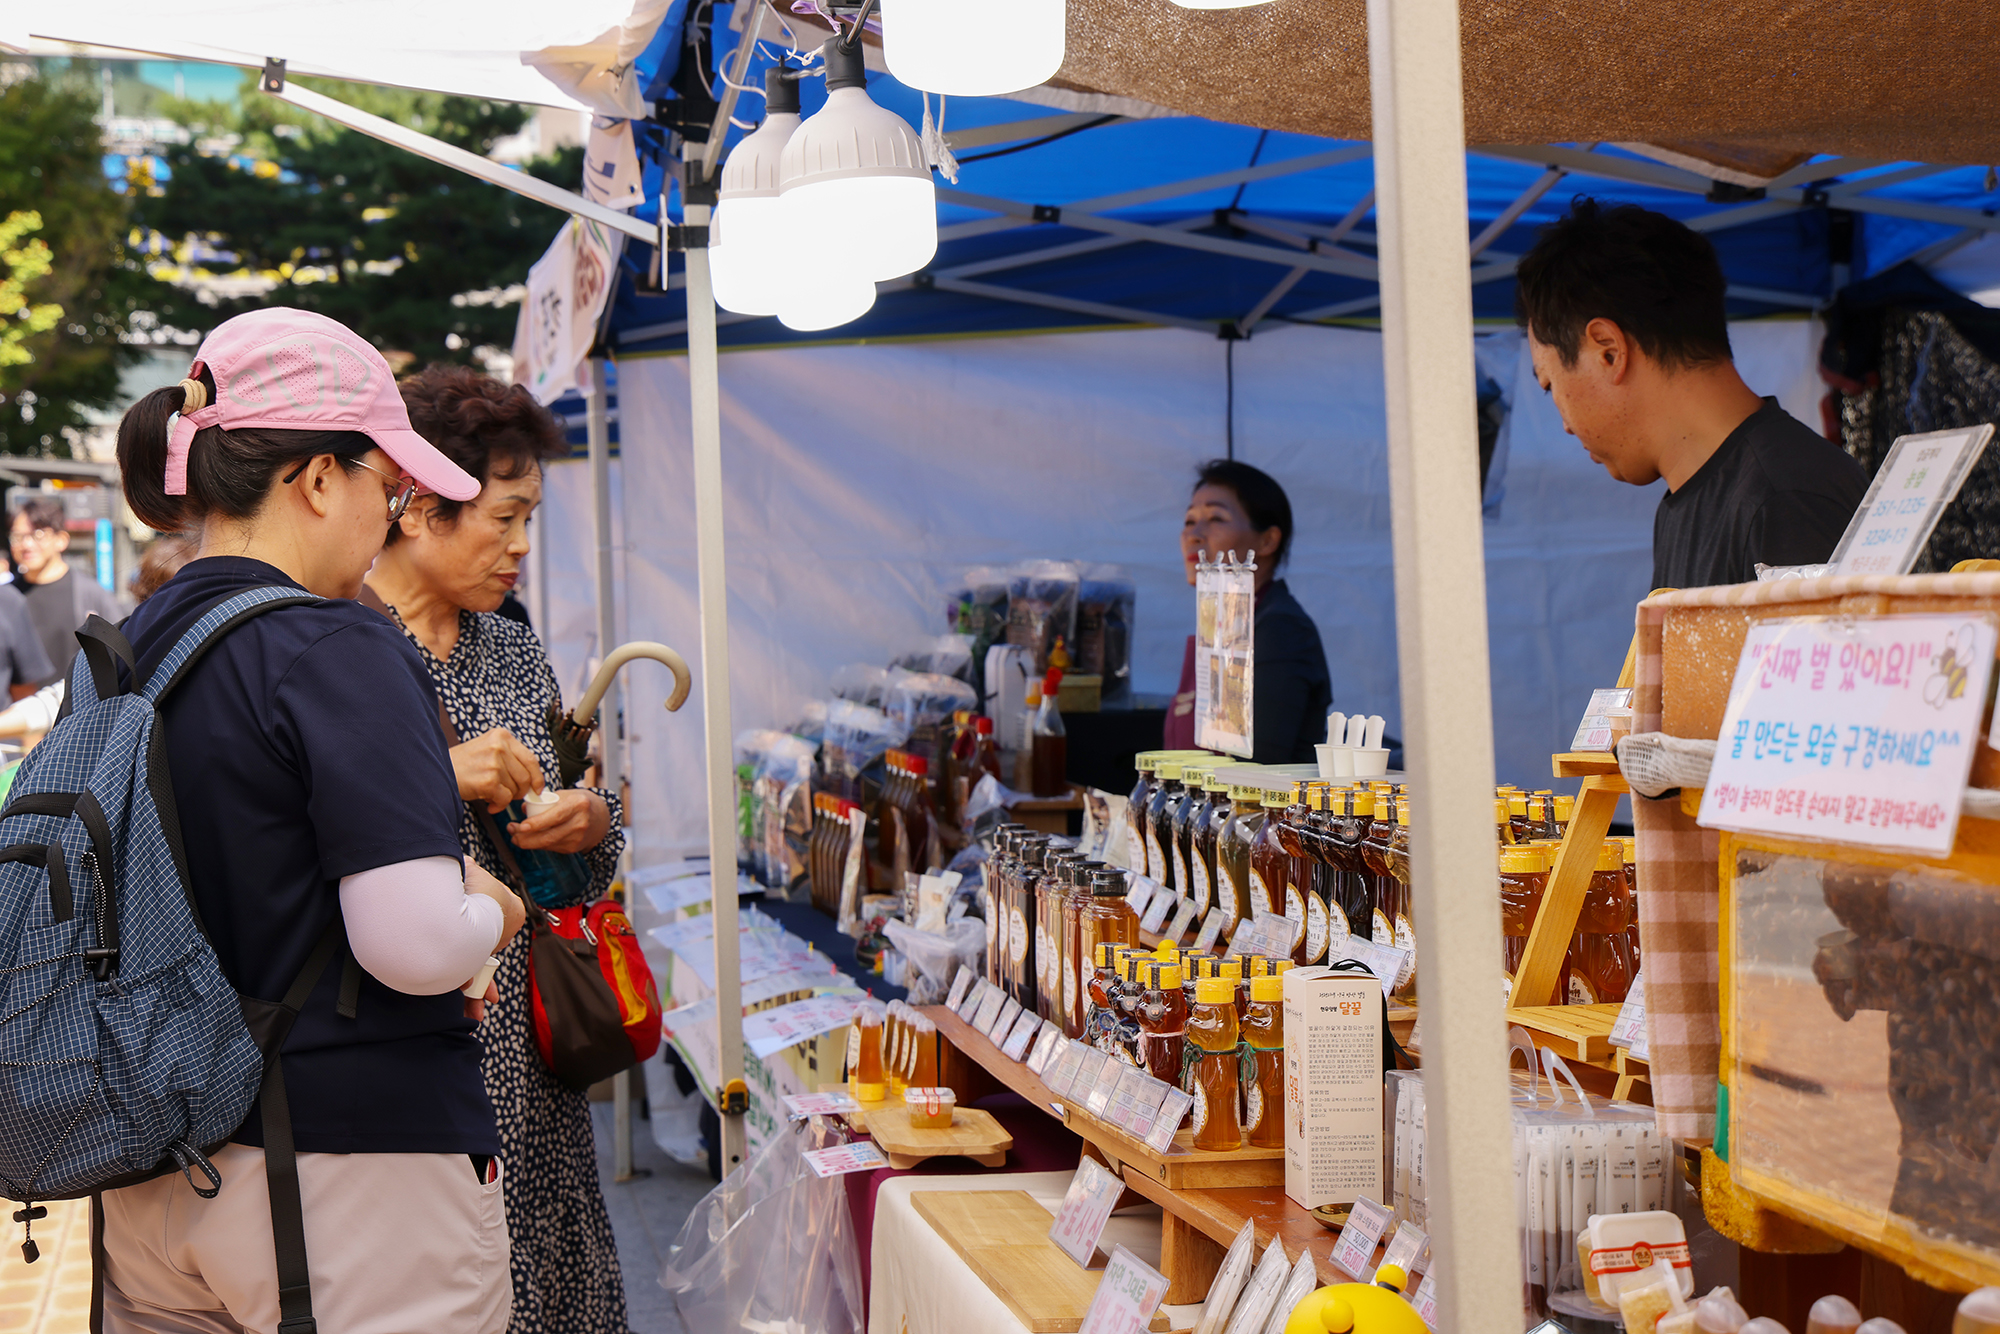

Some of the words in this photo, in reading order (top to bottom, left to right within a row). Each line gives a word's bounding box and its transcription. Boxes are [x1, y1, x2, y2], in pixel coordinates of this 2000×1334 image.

[1752, 642, 1801, 689] "진짜
[1810, 642, 1832, 691] 벌
[1839, 642, 1932, 692] 있어요!"
[1587, 729, 1609, 746] 4,000
[1731, 719, 1750, 760] 꿀
[1754, 721, 1800, 763] 만드는
[1804, 723, 1838, 766] 모습
[1843, 726, 1961, 770] 구경하세요^^
[1740, 785, 1771, 812] 놀라지
[1774, 788, 1806, 818] 않도록
[1807, 791, 1841, 820] 손대지
[1844, 795, 1867, 824] 말고
[1339, 1001, 1362, 1016] 달꿀
[1054, 1193, 1107, 1260] 무료시식
[1353, 1232, 1369, 1250] 50,000
[1341, 1245, 1365, 1274] 35,000
[1108, 1262, 1127, 1291] 자연
[1121, 1270, 1148, 1303] 그대로
